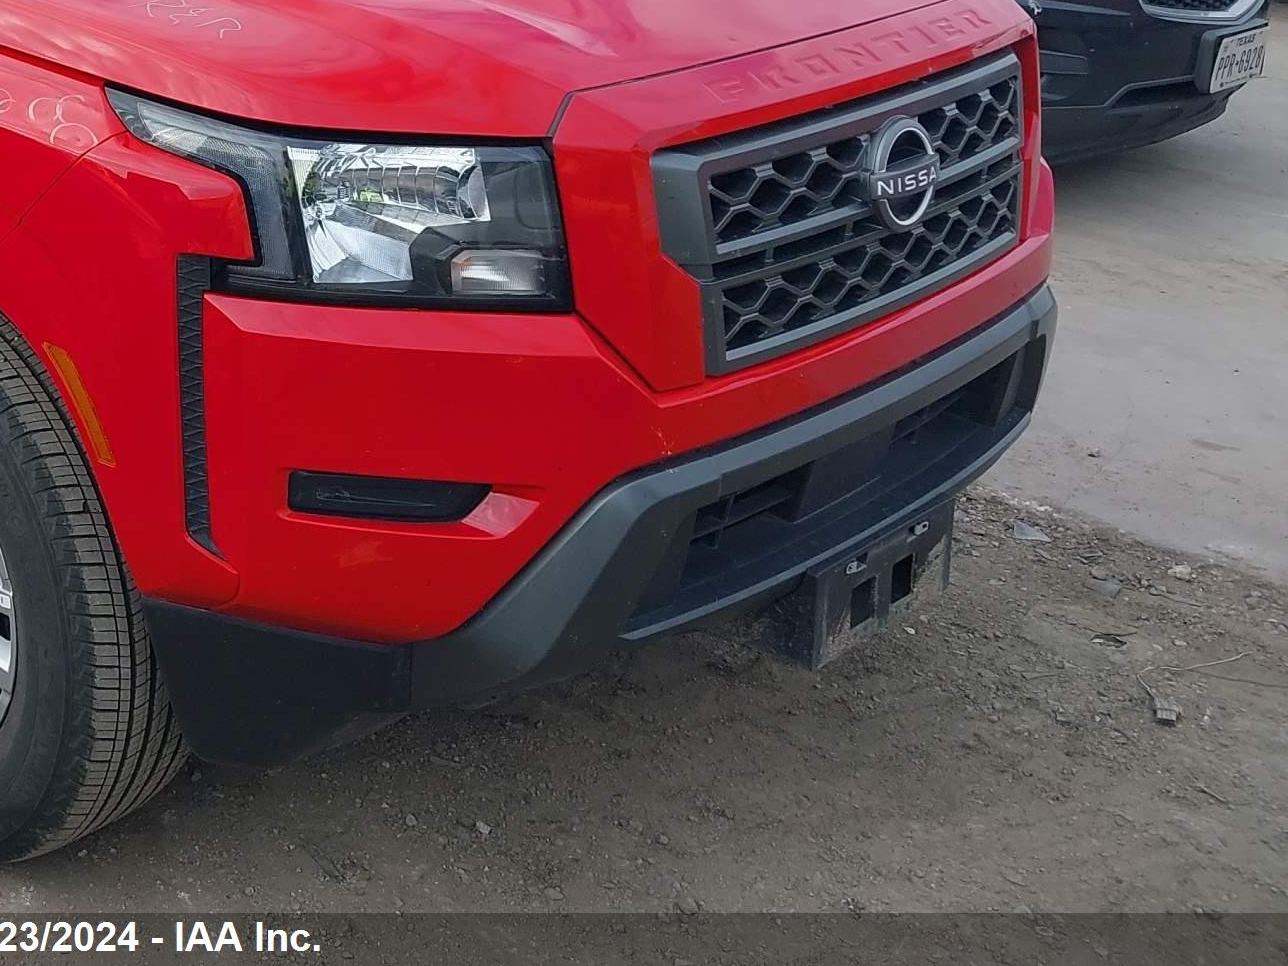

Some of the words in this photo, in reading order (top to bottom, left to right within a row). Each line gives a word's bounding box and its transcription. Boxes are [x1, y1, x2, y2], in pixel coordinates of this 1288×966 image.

[704, 8, 992, 104] FRONTIER
[1236, 33, 1257, 48] TEXAS
[877, 165, 940, 196] NISSA
